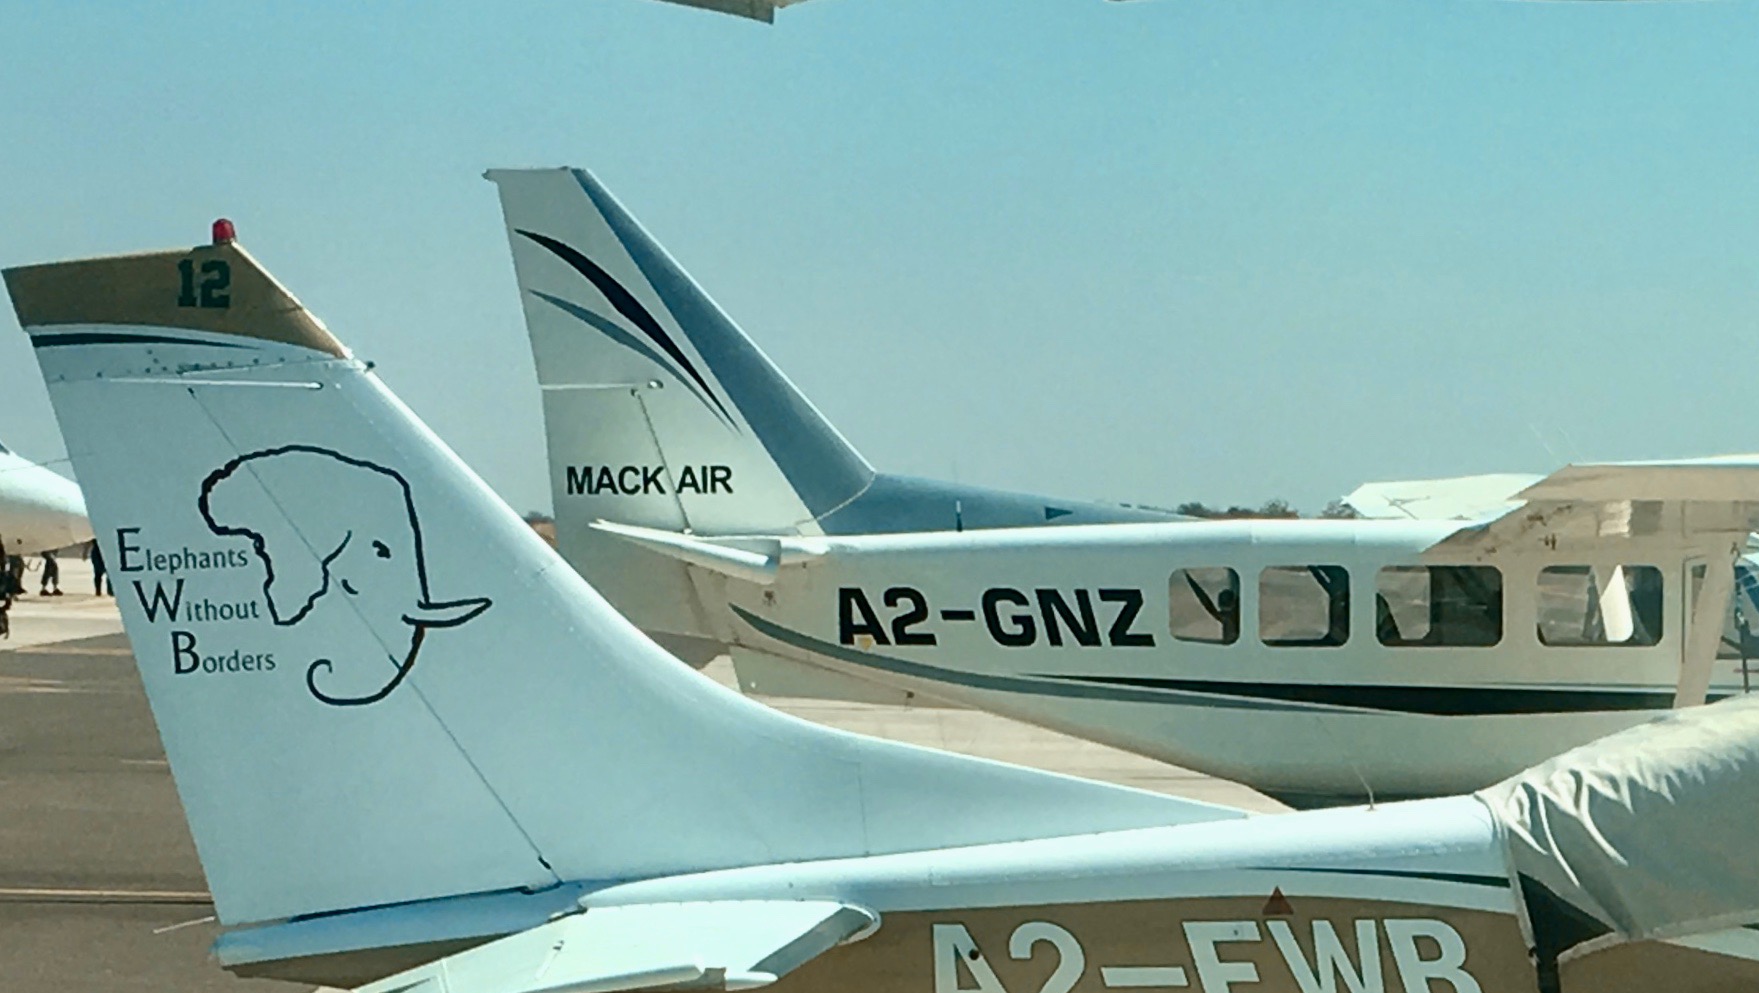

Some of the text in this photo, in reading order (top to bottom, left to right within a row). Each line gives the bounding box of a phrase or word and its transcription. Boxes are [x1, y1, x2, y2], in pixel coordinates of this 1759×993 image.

[178, 259, 231, 308] 12
[566, 464, 733, 495] MACK AIR
[116, 527, 248, 575] Elephants
[132, 578, 260, 623] Without
[838, 586, 1156, 647] A2-GNZ
[171, 630, 276, 674] Borders
